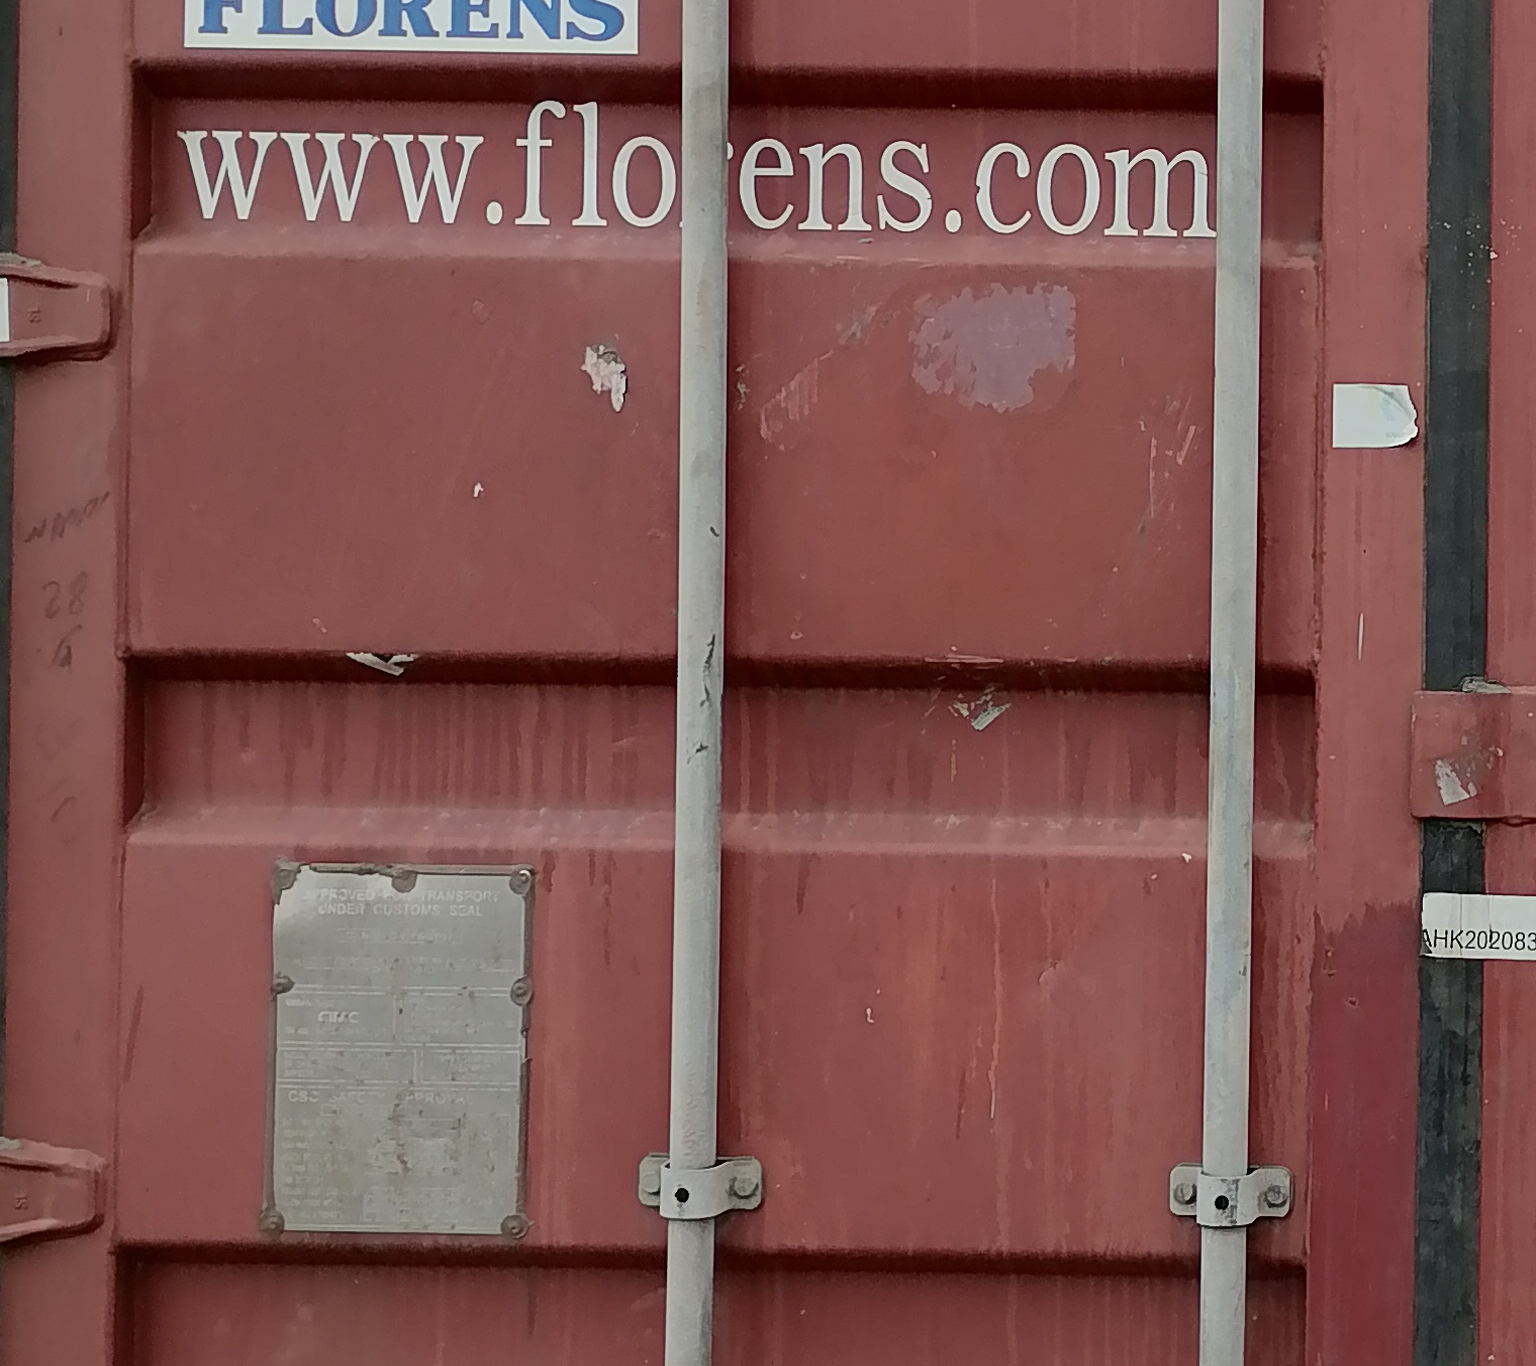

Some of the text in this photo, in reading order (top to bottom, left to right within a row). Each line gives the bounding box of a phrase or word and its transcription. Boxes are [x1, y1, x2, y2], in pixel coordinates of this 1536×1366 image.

[176, 100, 1217, 238] www.floens.com
[373, 904, 441, 916] CUSTOMS
[449, 905, 483, 917] SEAL
[288, 1090, 319, 1103] CSC
